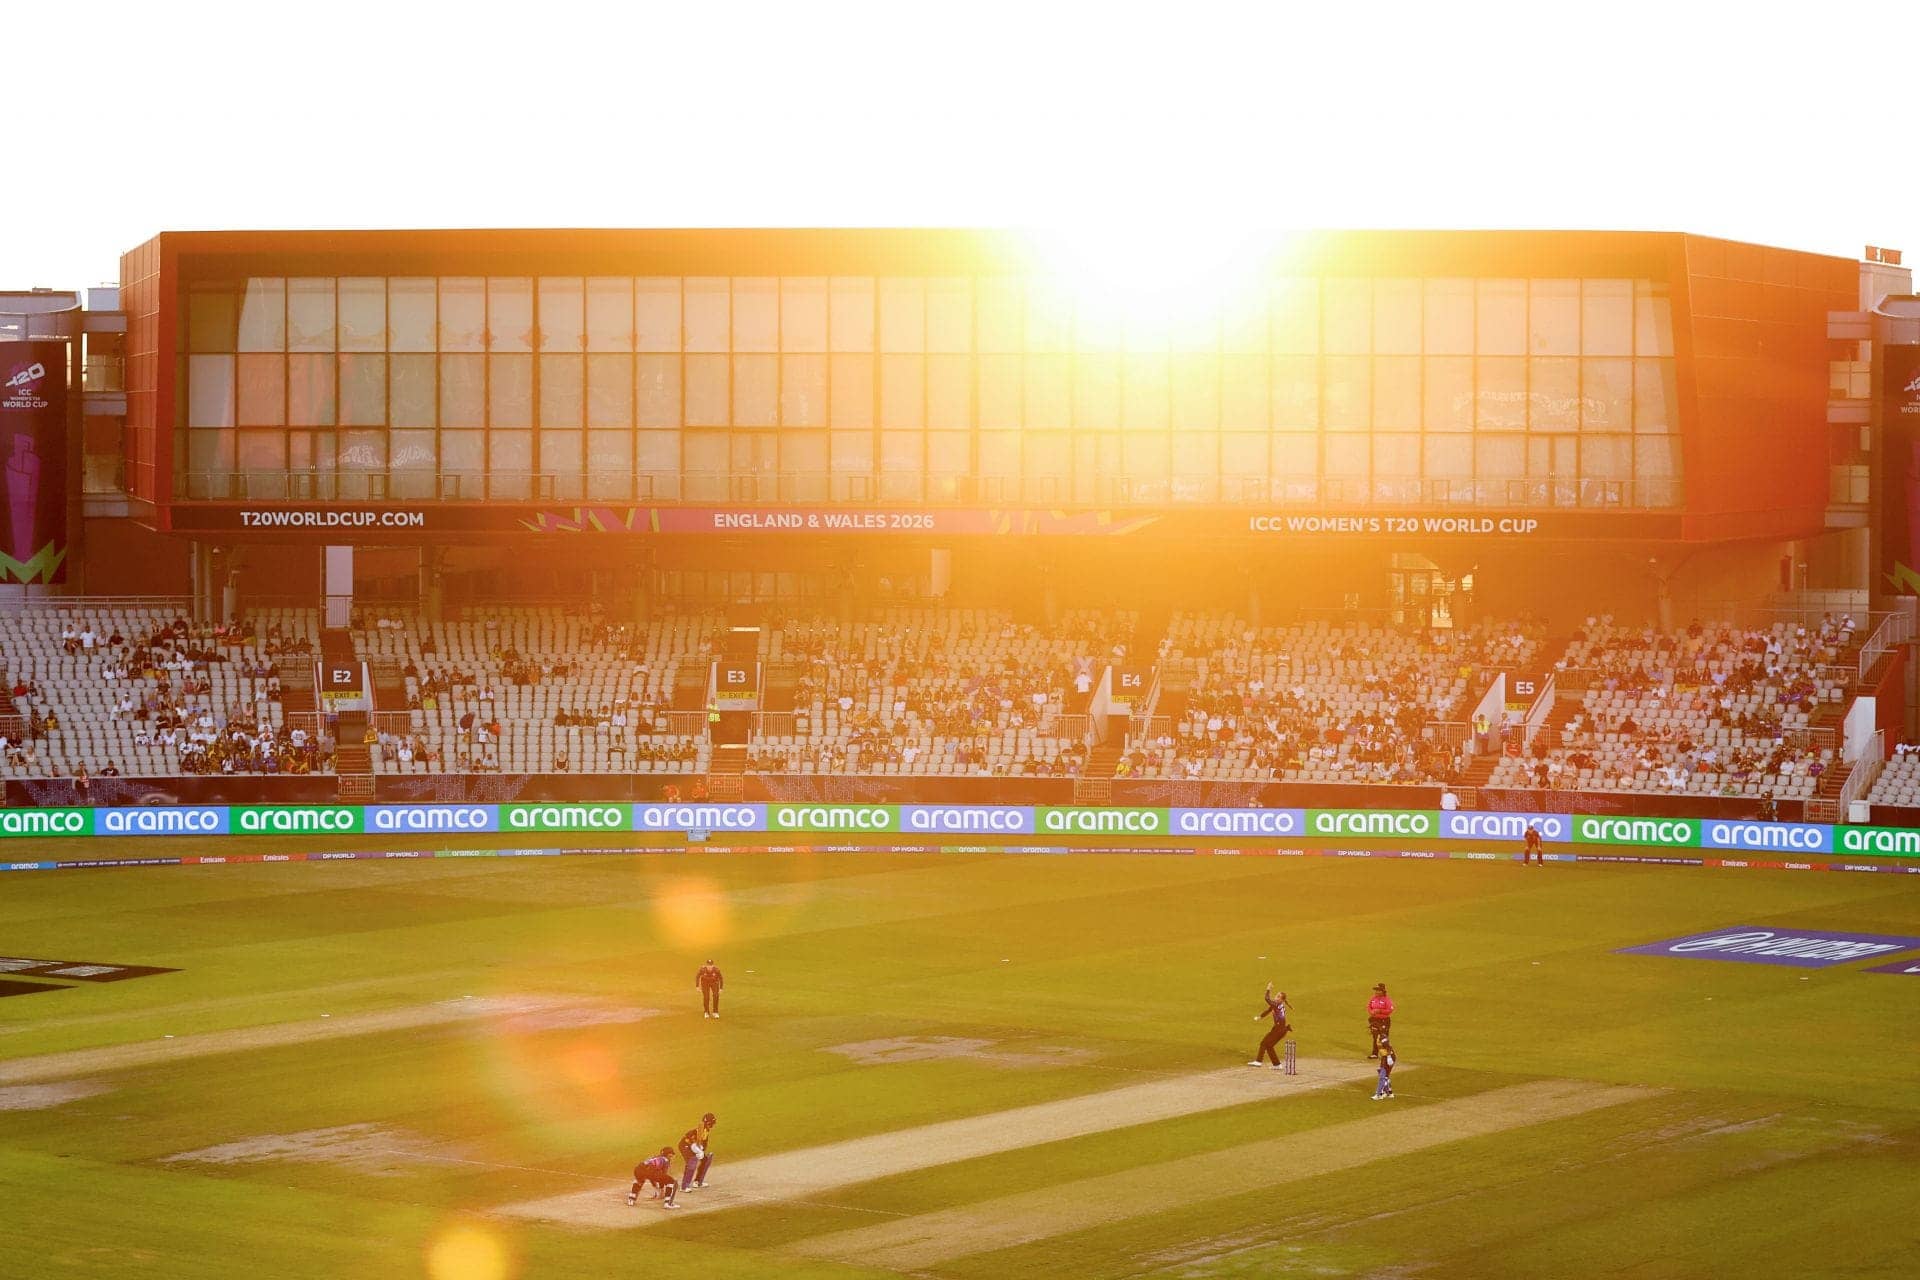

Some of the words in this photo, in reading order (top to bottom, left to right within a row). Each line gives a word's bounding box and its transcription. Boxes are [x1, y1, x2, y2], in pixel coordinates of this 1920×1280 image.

[241, 511, 424, 526] T20WORLDCUP.COM
[714, 513, 803, 528] ENGLAND
[807, 513, 820, 528] &
[824, 514, 887, 528] WALES
[891, 514, 935, 528] 2026
[1250, 517, 1282, 531] ICC
[1287, 517, 1380, 532] WOMEN'S
[1385, 518, 1419, 532] T20
[1423, 518, 1495, 533] WORLD
[1499, 519, 1538, 533] CUP
[333, 670, 351, 683] E2
[728, 670, 746, 683] E3
[1122, 674, 1141, 687] E4
[1516, 681, 1534, 695] E5
[105, 811, 219, 830] aramco
[241, 810, 354, 829] aramco
[375, 809, 488, 828] aramco
[510, 808, 622, 827] aramco
[644, 807, 756, 827] aramco
[778, 808, 890, 828] aramco
[911, 810, 1024, 829] aramco
[1045, 811, 1159, 831] aramco
[1180, 812, 1294, 832] aramco
[1316, 813, 1429, 833] aramco
[1582, 820, 1691, 843] aramco
[1712, 824, 1823, 848] aramco
